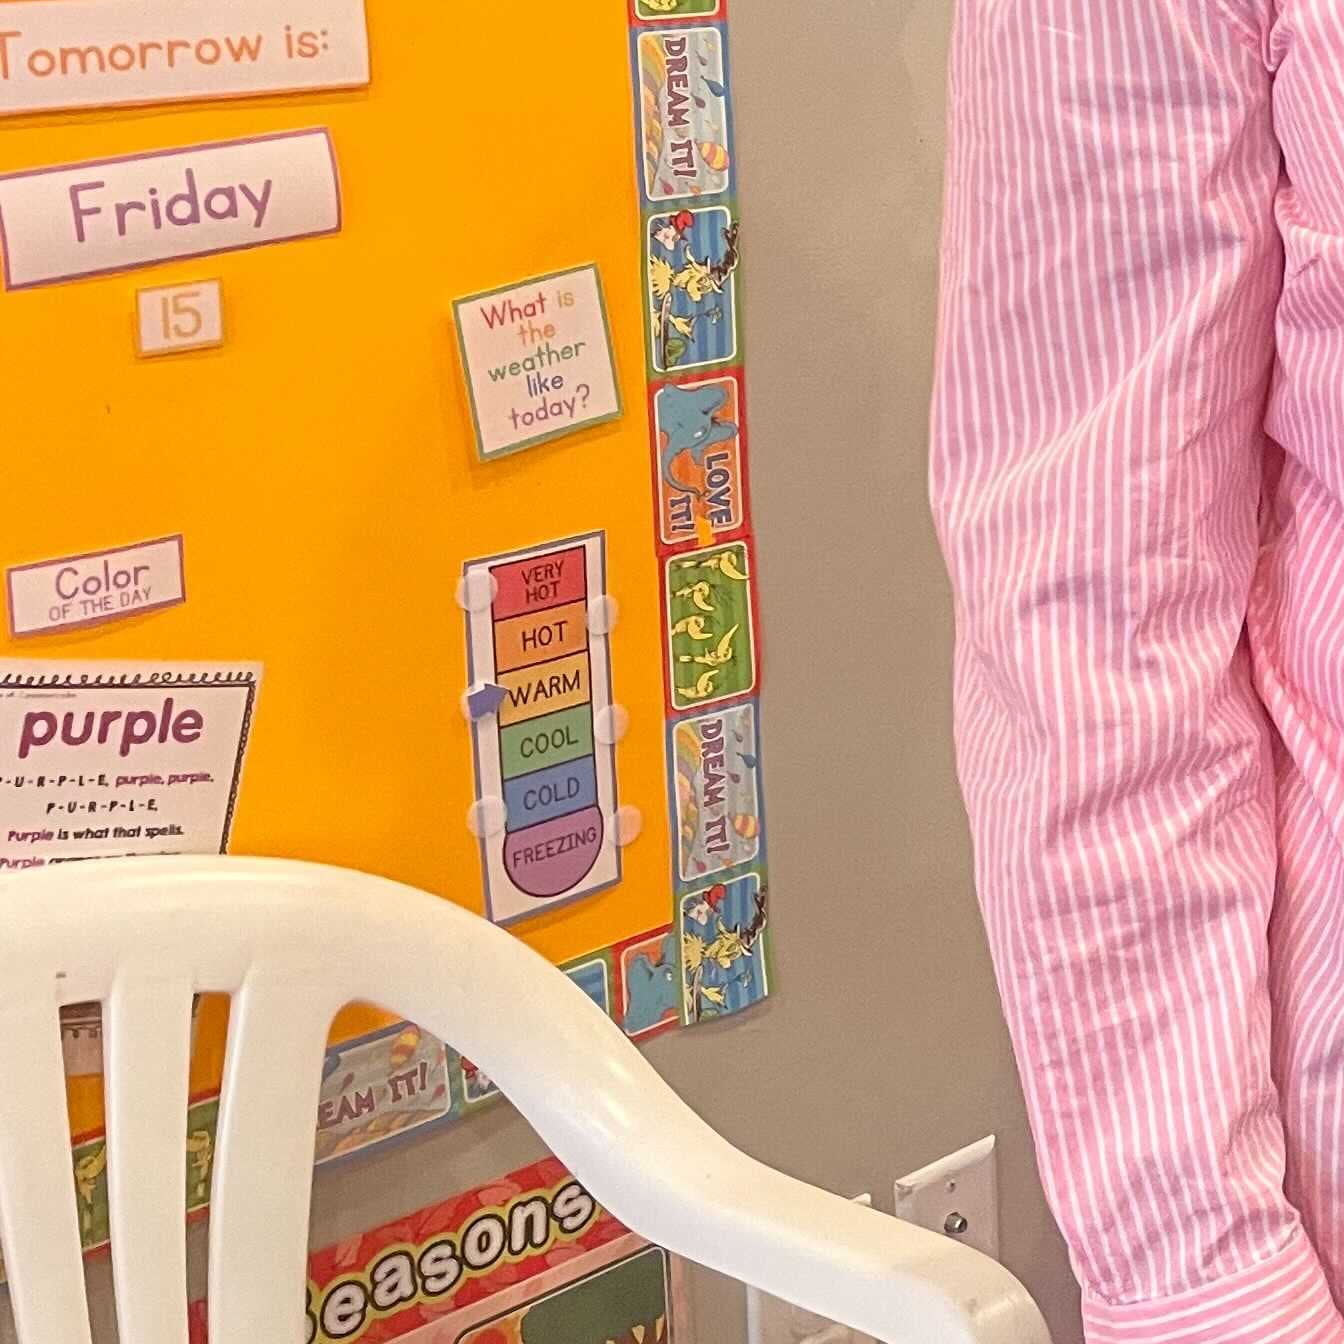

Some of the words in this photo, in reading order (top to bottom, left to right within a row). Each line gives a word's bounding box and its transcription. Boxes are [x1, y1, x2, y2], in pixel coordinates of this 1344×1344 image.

[0, 29, 263, 81] Tomorrow
[283, 24, 330, 59] is:
[664, 36, 690, 128] DREAM
[670, 138, 698, 178] IT!
[68, 167, 273, 243] Friday
[159, 290, 204, 341] 15
[480, 291, 548, 330] What
[556, 290, 576, 309] is
[517, 319, 557, 347] the
[487, 340, 588, 383] weather
[525, 372, 565, 398] like
[509, 383, 592, 430] today?
[705, 452, 733, 527] LOVE
[669, 493, 695, 532] IT!
[54, 559, 151, 601] Color
[520, 559, 565, 585] VERY
[48, 601, 73, 623] OF
[79, 595, 114, 617] THE
[119, 586, 153, 608] DAY
[525, 580, 562, 605] HOT
[520, 621, 569, 653] HOT
[507, 669, 582, 709] WARM
[17, 696, 205, 760] purple
[518, 726, 580, 759] COOL
[701, 718, 727, 808] DREAM
[521, 775, 582, 812] COLD
[7, 829, 54, 845] Purple
[56, 827, 69, 841] is
[73, 826, 110, 841] what
[112, 825, 141, 839] that
[511, 826, 598, 870] FREEZING
[705, 816, 731, 855] IT!
[318, 1088, 376, 1129] EAM
[388, 1061, 428, 1104] IT!
